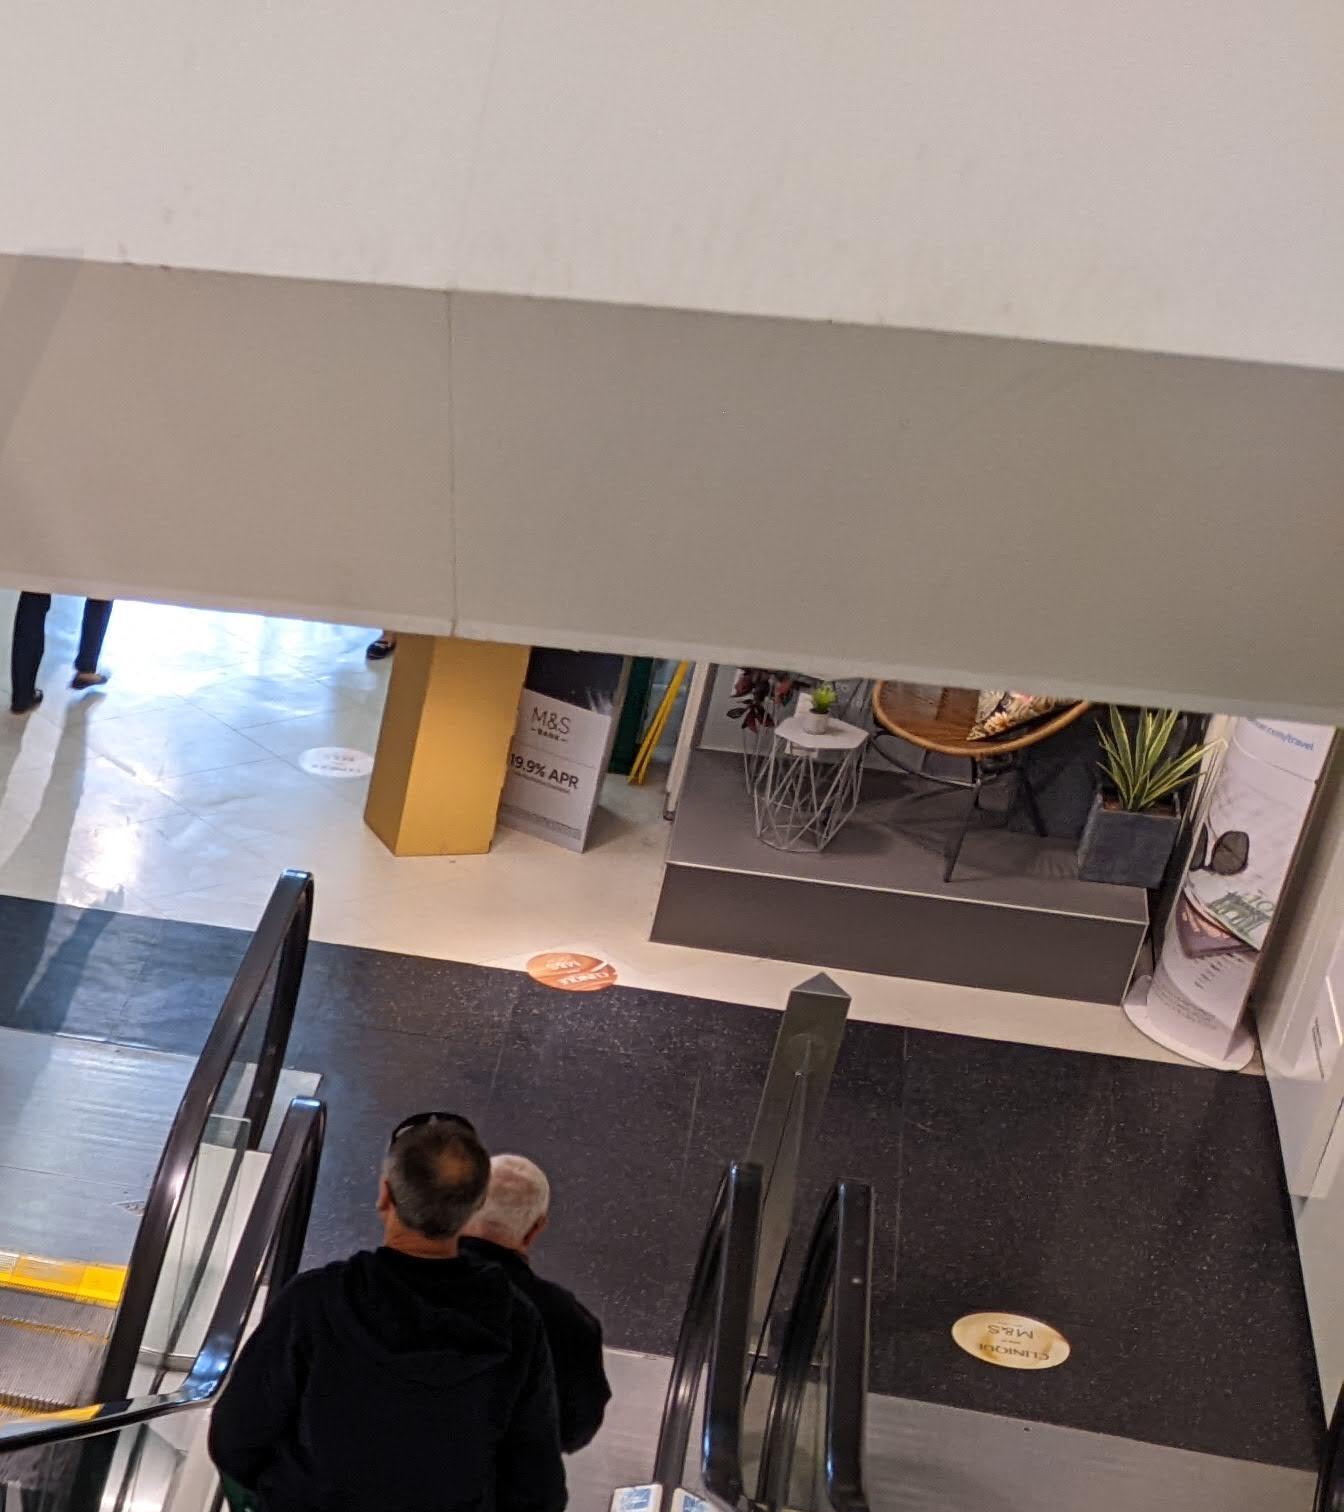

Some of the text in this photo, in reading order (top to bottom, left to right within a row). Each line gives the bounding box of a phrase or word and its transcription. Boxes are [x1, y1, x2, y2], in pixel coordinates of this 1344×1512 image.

[531, 706, 572, 735] M&S
[548, 768, 580, 790] APR
[987, 1324, 1034, 1339] M&S
